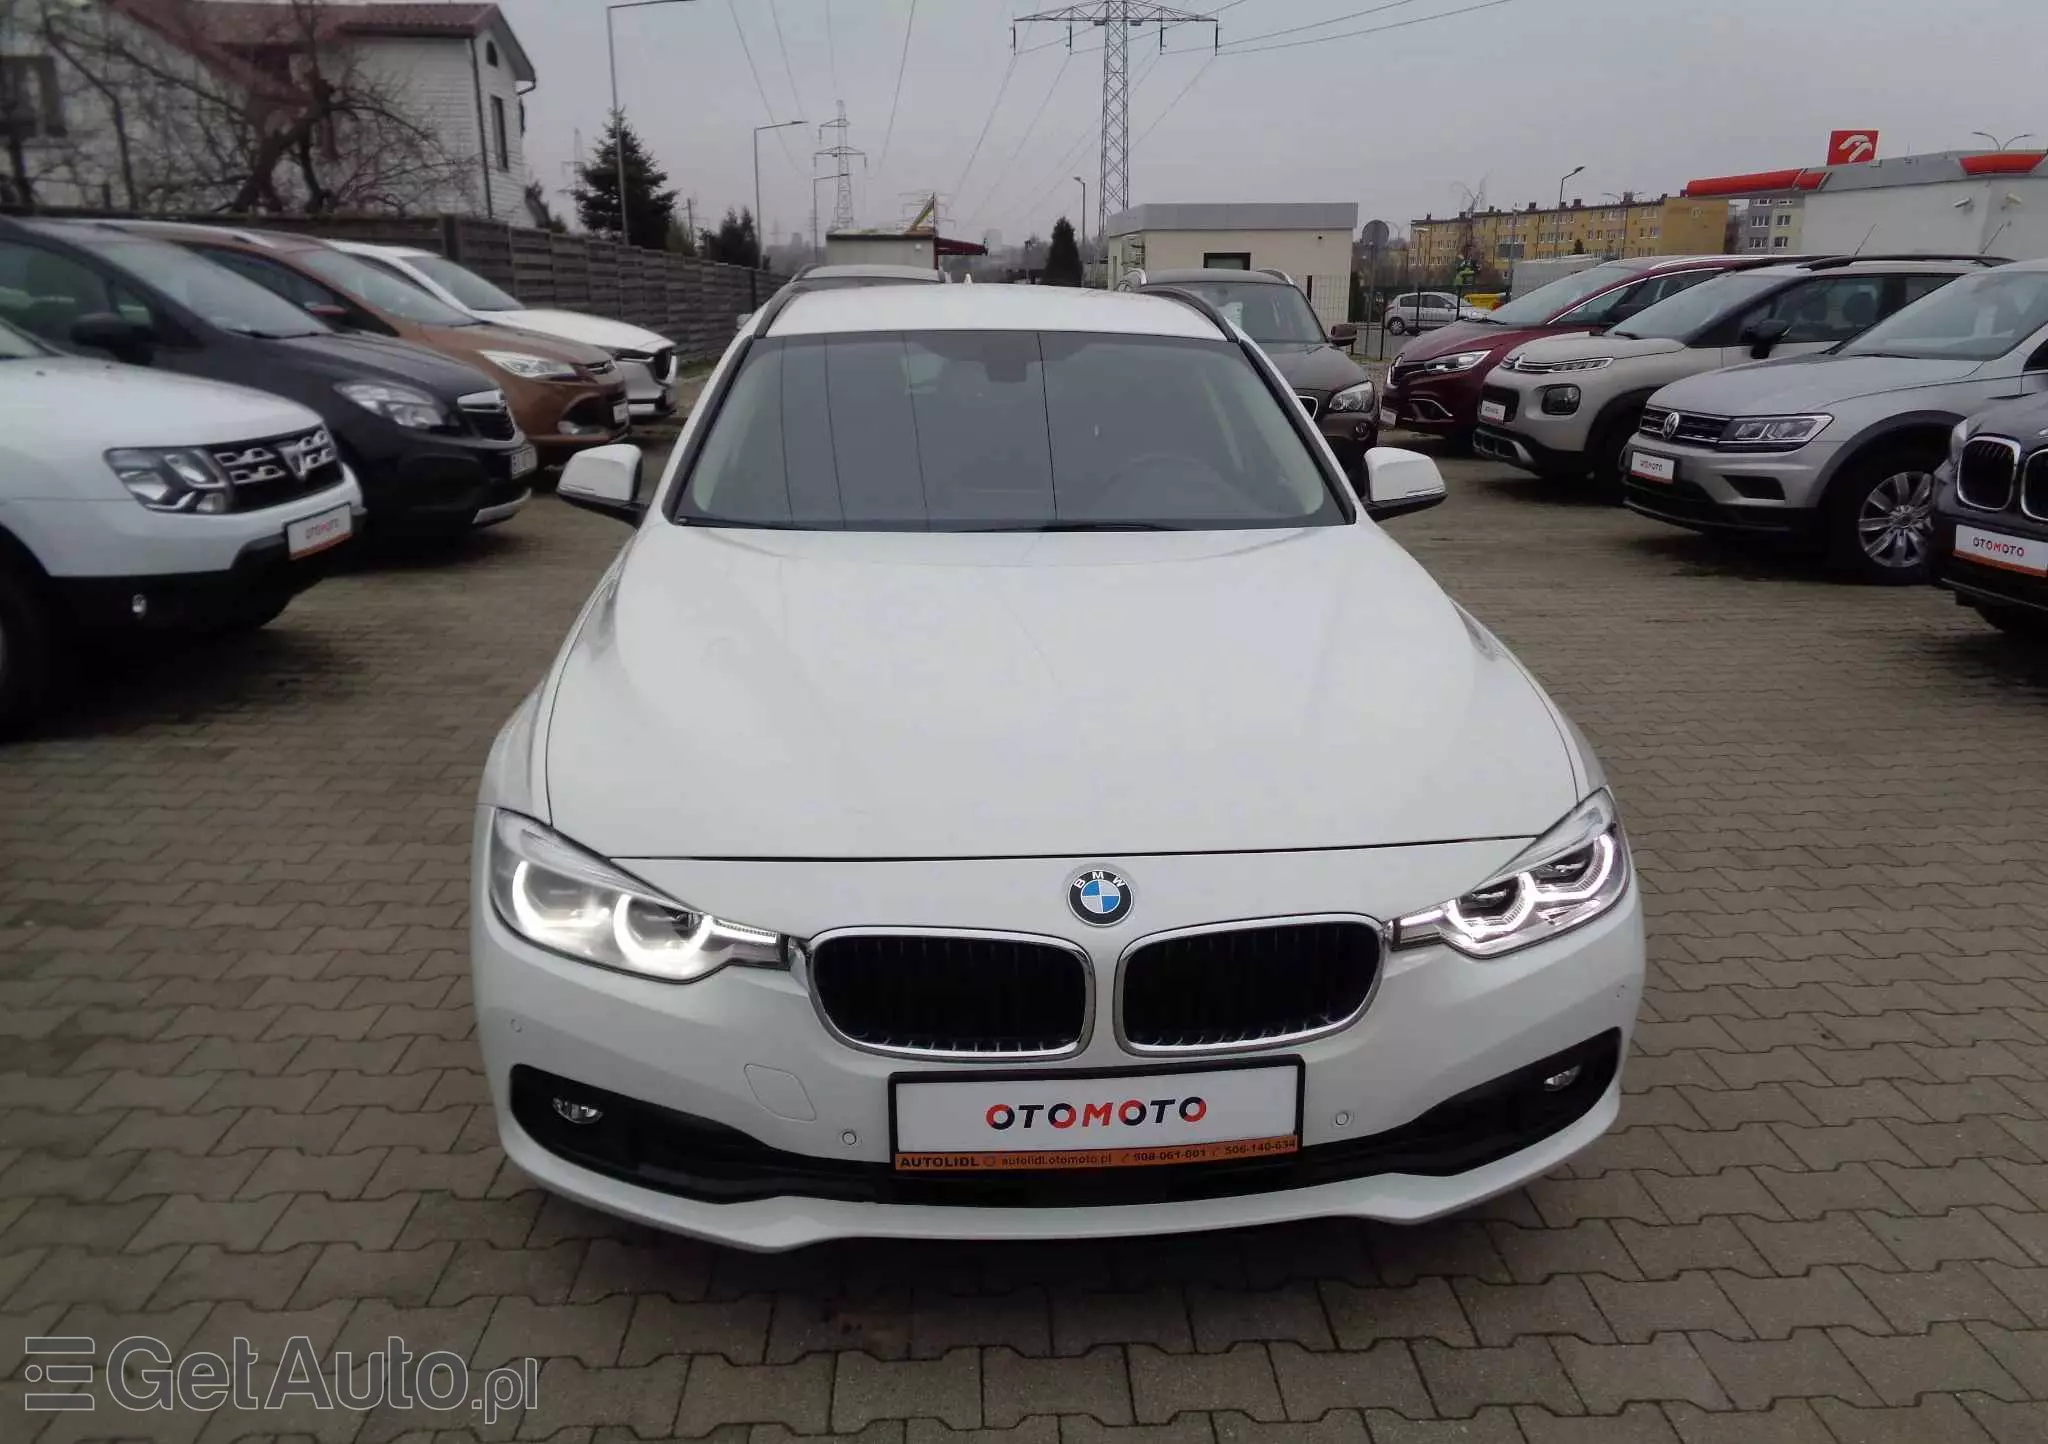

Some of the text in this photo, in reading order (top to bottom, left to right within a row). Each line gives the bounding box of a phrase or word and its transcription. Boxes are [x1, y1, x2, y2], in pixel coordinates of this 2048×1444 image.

[1973, 537, 2025, 557] OTOMOTO
[1073, 871, 1126, 889] BMW
[986, 1096, 1207, 1131] OTOMOTO
[899, 1156, 980, 1168] AUTOLIDL
[1002, 1152, 1112, 1165] autolidl.otomoto.pl
